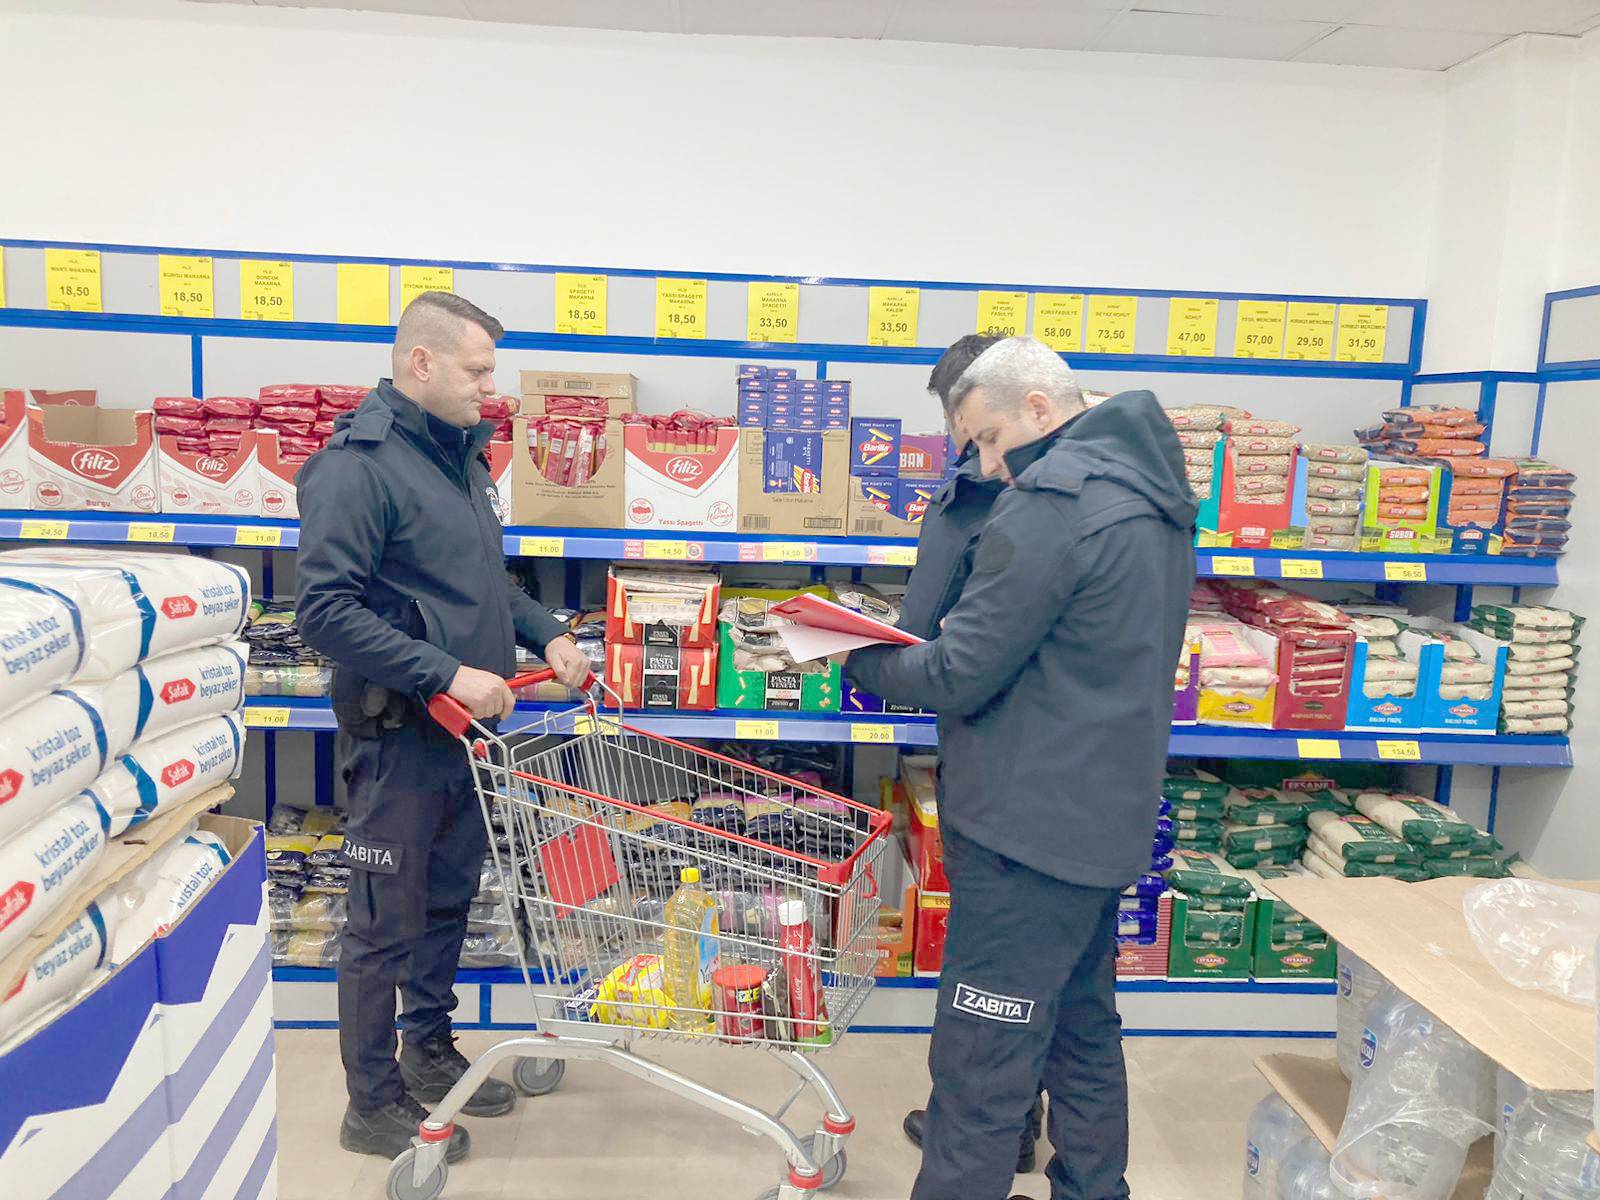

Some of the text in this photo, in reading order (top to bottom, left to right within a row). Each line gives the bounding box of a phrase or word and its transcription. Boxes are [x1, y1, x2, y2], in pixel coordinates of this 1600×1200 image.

[60, 286, 90, 298] 18,50
[174, 292, 203, 303] 18,50
[254, 296, 283, 307] 18,50
[568, 309, 596, 320] 18,50
[668, 314, 696, 325] 18,50
[760, 318, 788, 329] 33,50
[880, 322, 908, 333] 33,50
[1044, 327, 1072, 338] 58,00
[1097, 329, 1125, 340] 73,50
[1177, 332, 1206, 343] 47,00
[1246, 334, 1273, 345] 57,00
[1296, 336, 1324, 347] 29,50
[1348, 338, 1376, 349] 31,50
[863, 443, 889, 452] Barilla
[79, 453, 113, 472] filiz
[201, 460, 225, 473] filiz
[671, 460, 701, 476] filiz
[199, 583, 225, 600] kristal
[202, 600, 224, 618] beyaz
[37, 615, 61, 634] toz
[2, 647, 44, 676] beyaz
[649, 657, 674, 665] PASTA
[199, 665, 223, 681] kristal
[771, 676, 797, 684] PASTA
[199, 682, 222, 699] beyaz
[263, 716, 284, 724] 11,00
[26, 724, 82, 763] kristal toz
[193, 736, 217, 757] kristal
[198, 754, 219, 774] beyaz
[29, 758, 65, 788] beyaz
[34, 819, 91, 869] kristal toz
[343, 840, 393, 866] ZABITA
[40, 854, 76, 892] beyaz
[34, 949, 69, 981] beyaz
[962, 991, 1023, 1018] ZABITA
